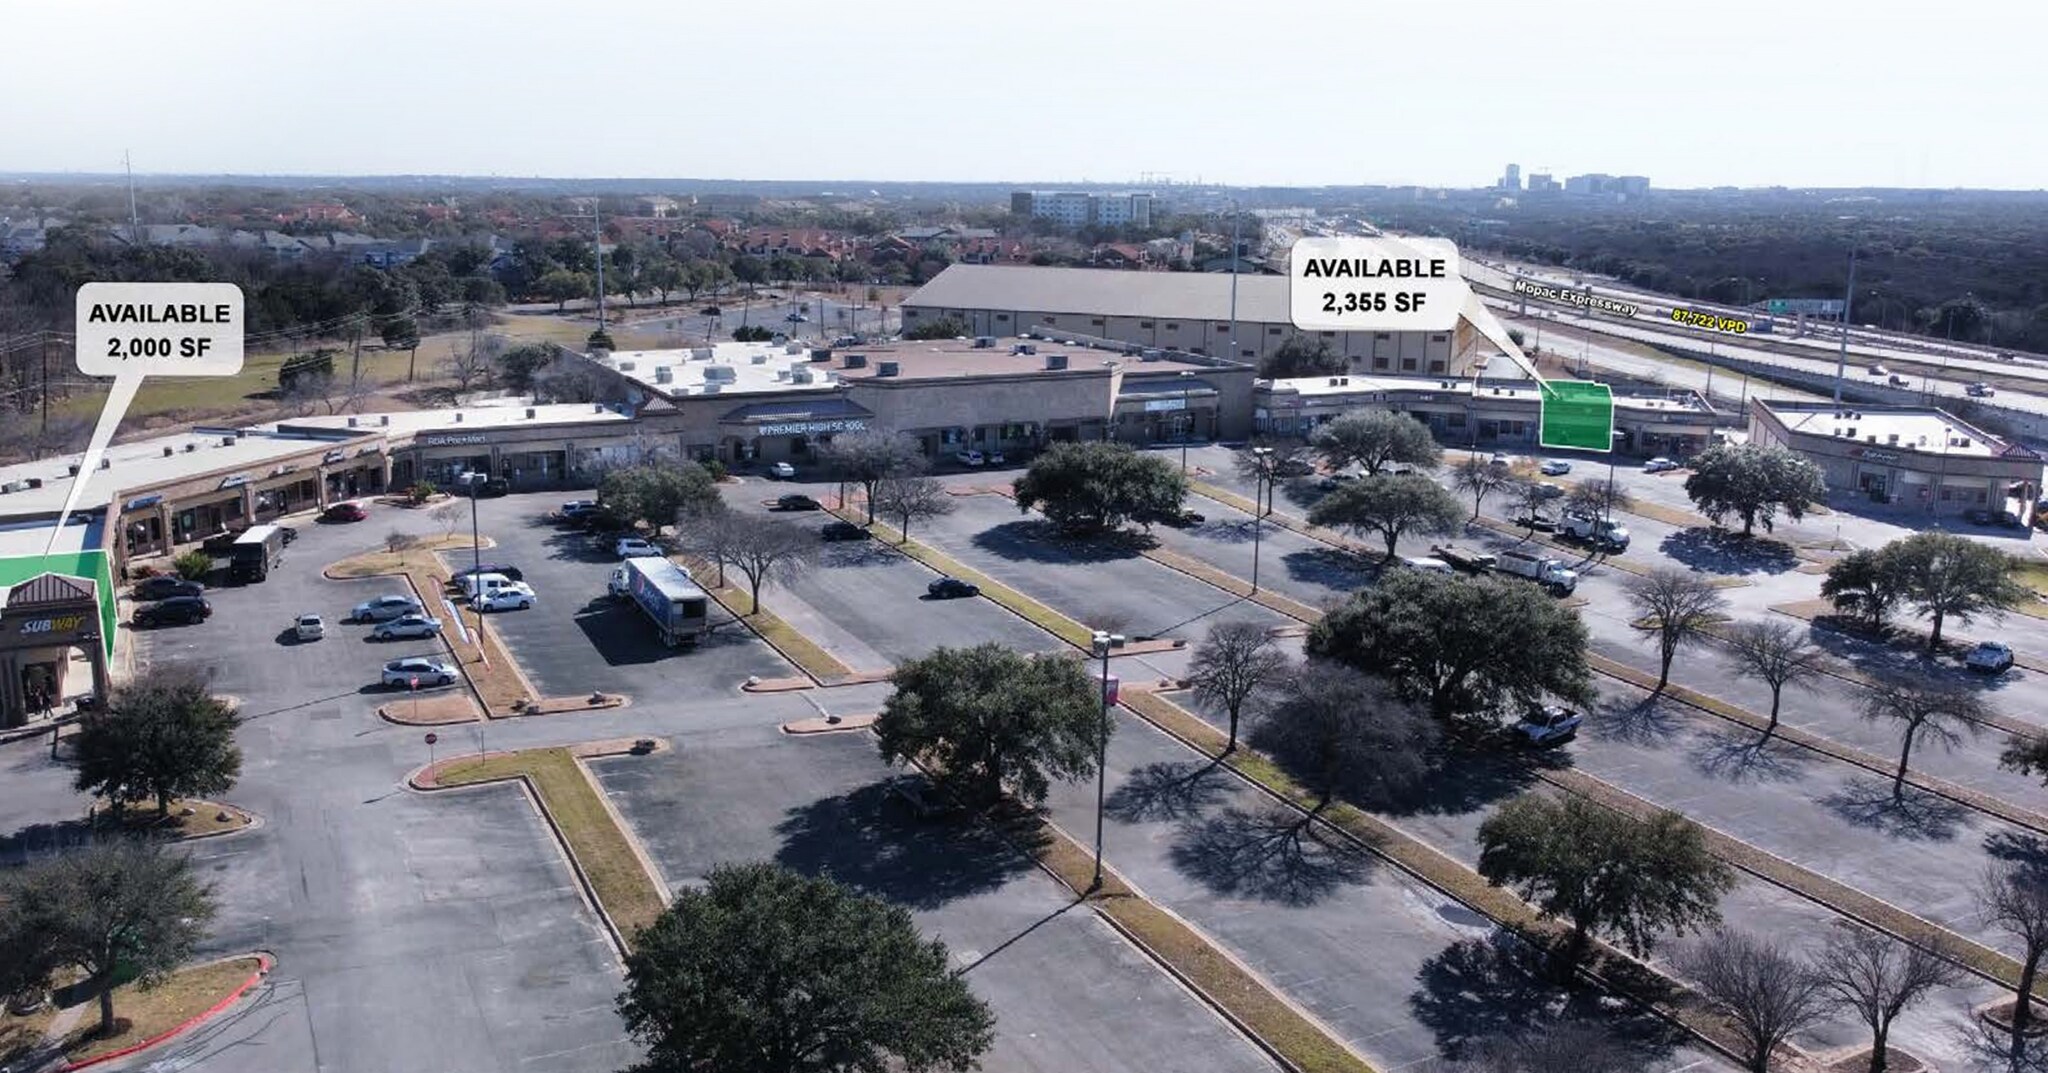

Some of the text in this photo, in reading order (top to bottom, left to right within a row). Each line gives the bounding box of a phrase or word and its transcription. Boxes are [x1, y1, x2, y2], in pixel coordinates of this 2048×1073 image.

[766, 423, 807, 435] PREMIER
[808, 422, 830, 433] HIGH
[20, 615, 84, 634] SUBWAY
